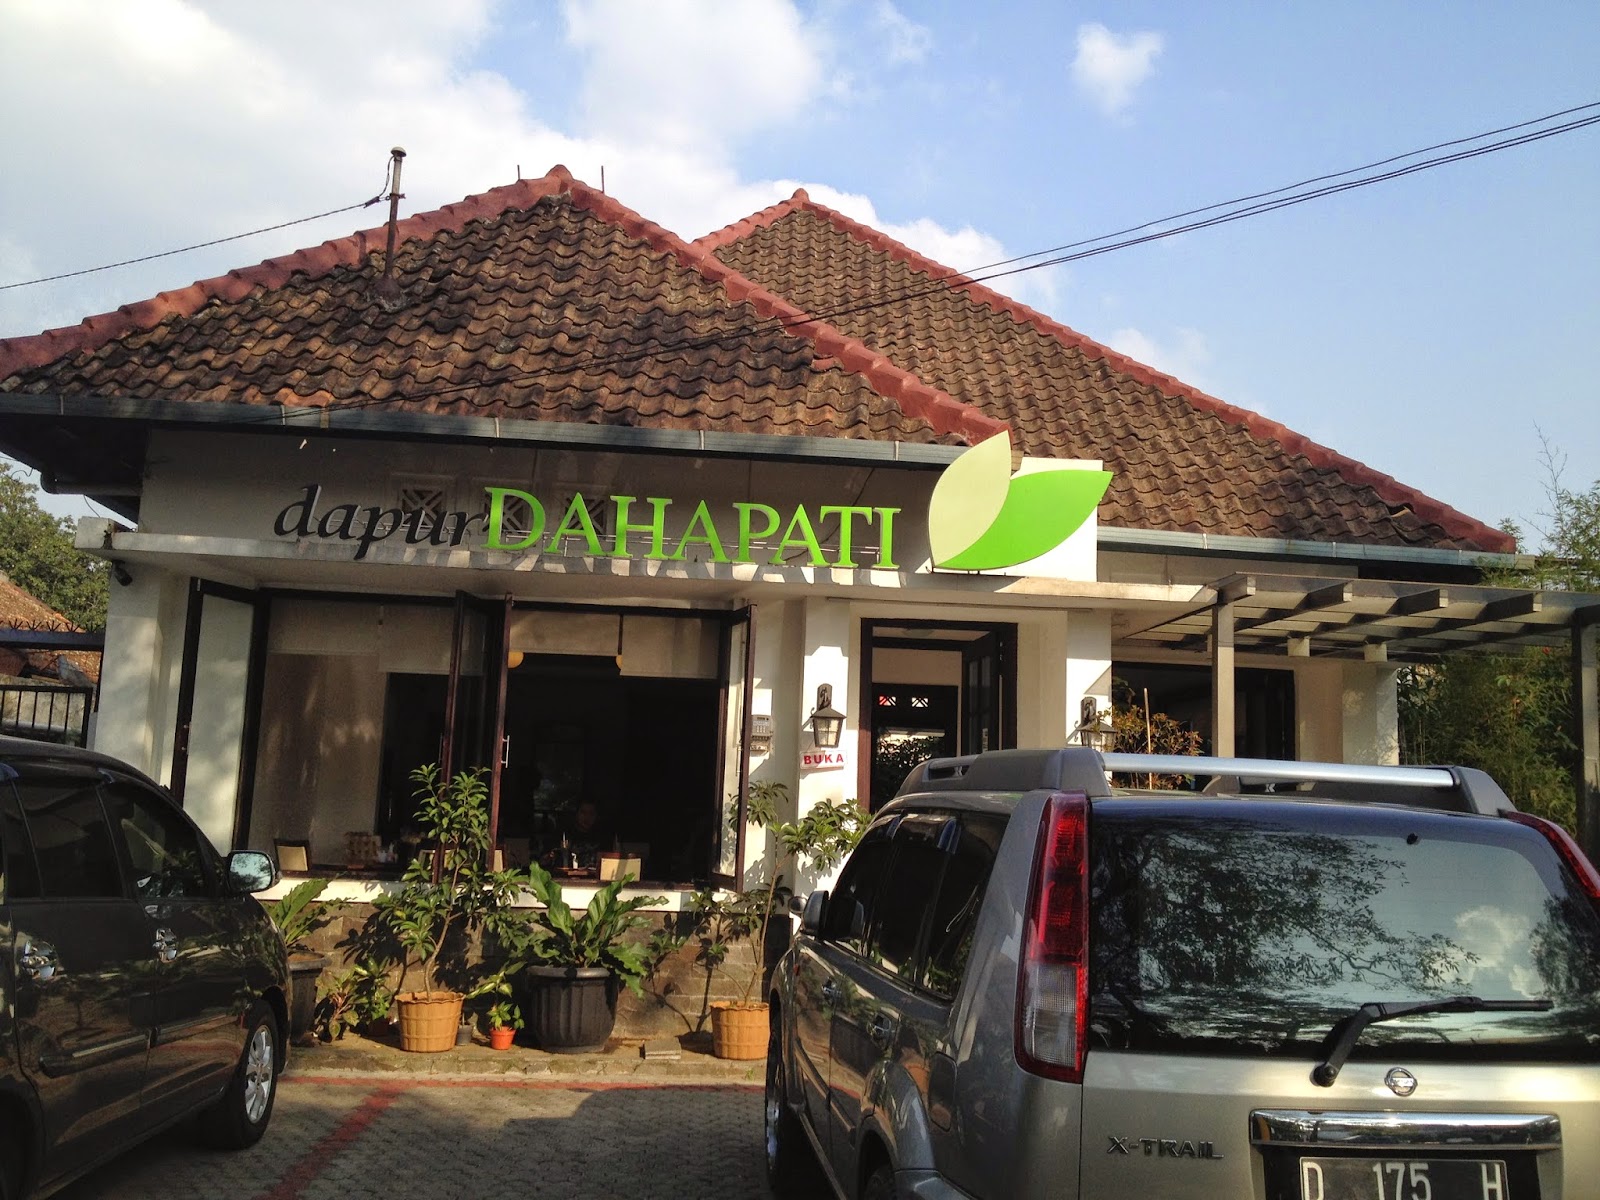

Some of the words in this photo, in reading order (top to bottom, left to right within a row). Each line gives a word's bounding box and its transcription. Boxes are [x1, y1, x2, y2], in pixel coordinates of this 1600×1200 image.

[274, 484, 487, 560] dapur
[484, 486, 902, 570] DAHAPATI
[803, 753, 844, 765] BUKA
[1107, 1136, 1225, 1159] X-TRAIL
[1302, 1161, 1325, 1200] D
[1372, 1162, 1432, 1200] 175
[1481, 1163, 1503, 1200] H
